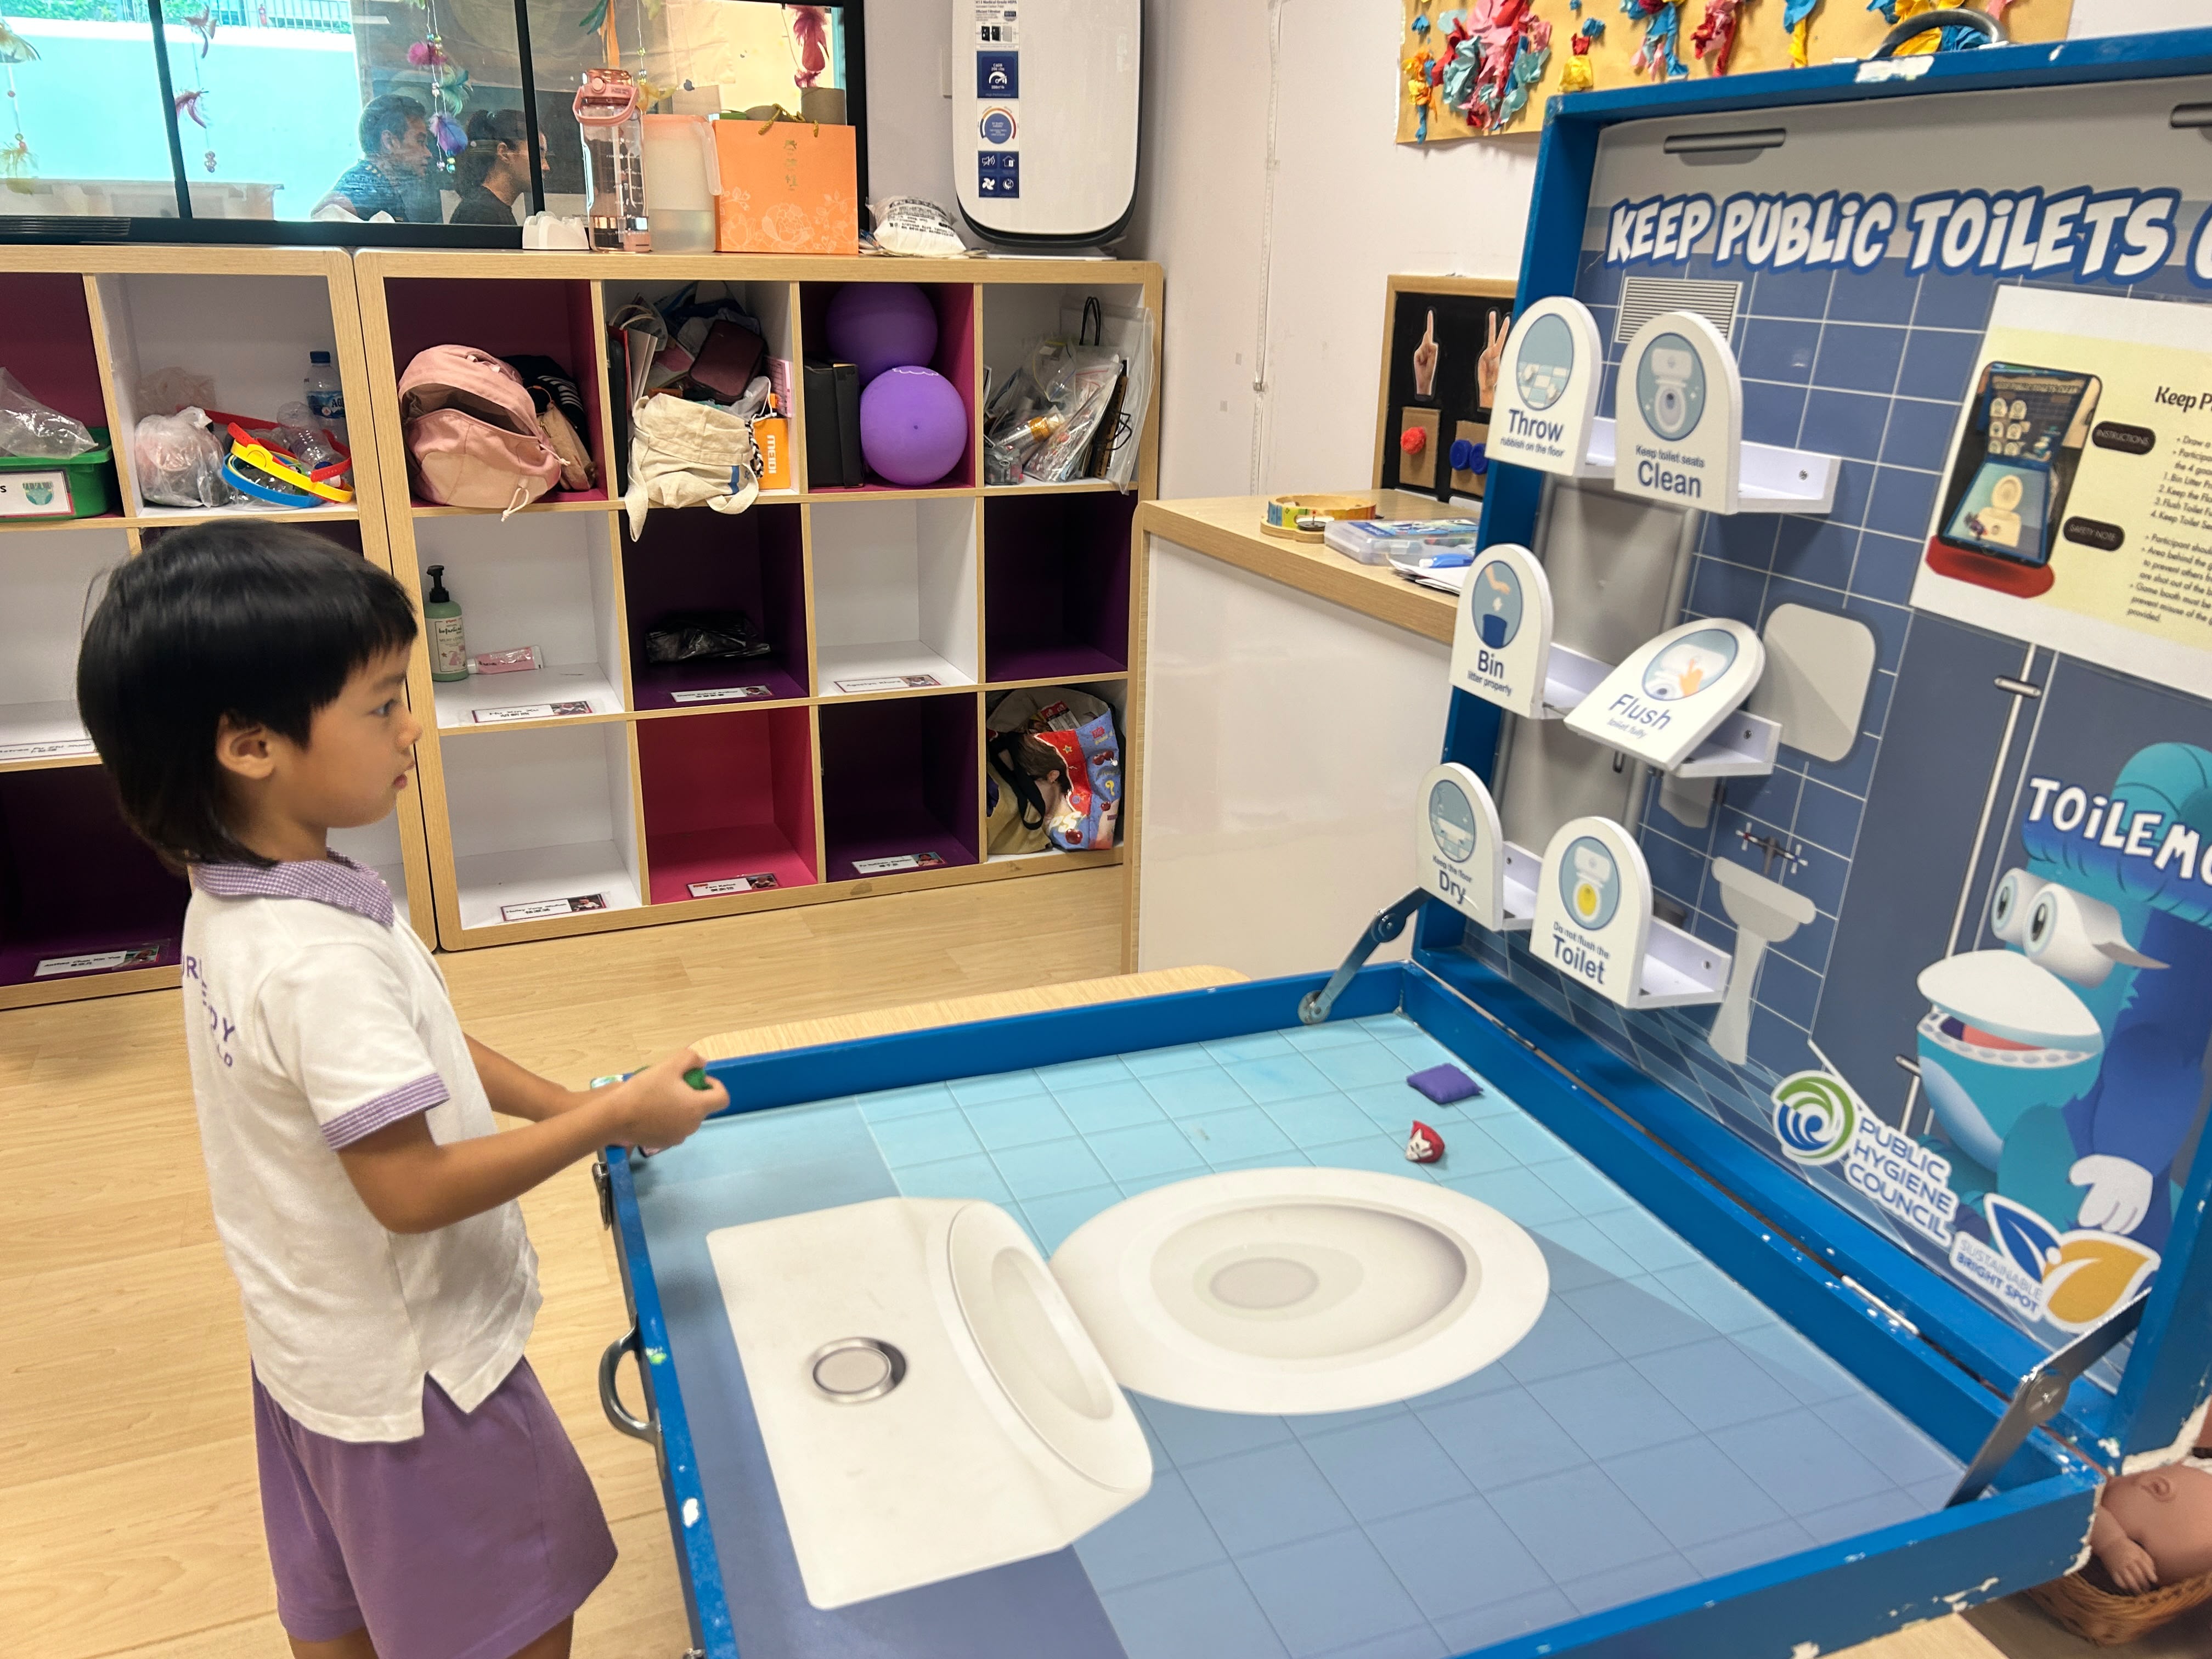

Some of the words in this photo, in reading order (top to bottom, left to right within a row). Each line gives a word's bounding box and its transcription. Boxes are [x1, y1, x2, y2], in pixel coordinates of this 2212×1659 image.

[1605, 198, 1713, 264] KEEP
[2154, 386, 2197, 413] Keep
[1509, 408, 1564, 443] Throw
[2096, 428, 2150, 447] INSTRUCTIONS
[1500, 438, 1524, 449] rubbish
[1525, 443, 1534, 452] on
[1536, 443, 1546, 454] the
[1547, 445, 1565, 457] floor
[1635, 444, 1656, 460] Keep
[1658, 449, 1680, 464] toilet
[1681, 455, 1706, 467] seats
[1638, 460, 1701, 498] Clean
[2180, 515, 2200, 527] Toilet
[2183, 502, 2203, 514] Toilet
[2147, 546, 2166, 557] Area
[2167, 549, 2194, 564] behind
[2139, 572, 2152, 580] are
[2183, 581, 2193, 590] of
[2151, 562, 2180, 573] prevent
[2181, 568, 2203, 580] others
[2136, 582, 2159, 595] Game
[2185, 609, 2195, 617] of
[1477, 650, 1504, 679] Bin
[1467, 670, 1482, 684] litter
[1483, 679, 1513, 697] properly
[1608, 693, 1671, 730] Flush
[1606, 718, 1630, 731] toilet
[1628, 726, 1647, 739] fully
[1432, 855, 1447, 869] Keep
[1447, 864, 1457, 874] the
[1458, 869, 1472, 883] floor
[1439, 869, 1466, 905] Dry
[1553, 921, 1563, 933] Do
[1564, 929, 1576, 941] not
[1577, 934, 1595, 951] flush
[1596, 946, 1610, 959] the
[1552, 933, 1605, 985] Toilet
[1858, 1116, 1945, 1183] PUBLIC
[1853, 1138, 1952, 1215] HYGIENE
[1849, 1163, 1946, 1240] COUNCIL
[1956, 1251, 2003, 1289] BRIGHT
[2005, 1284, 2038, 1313] SPOT
[1960, 1239, 2043, 1300] SUSTAINABLE
